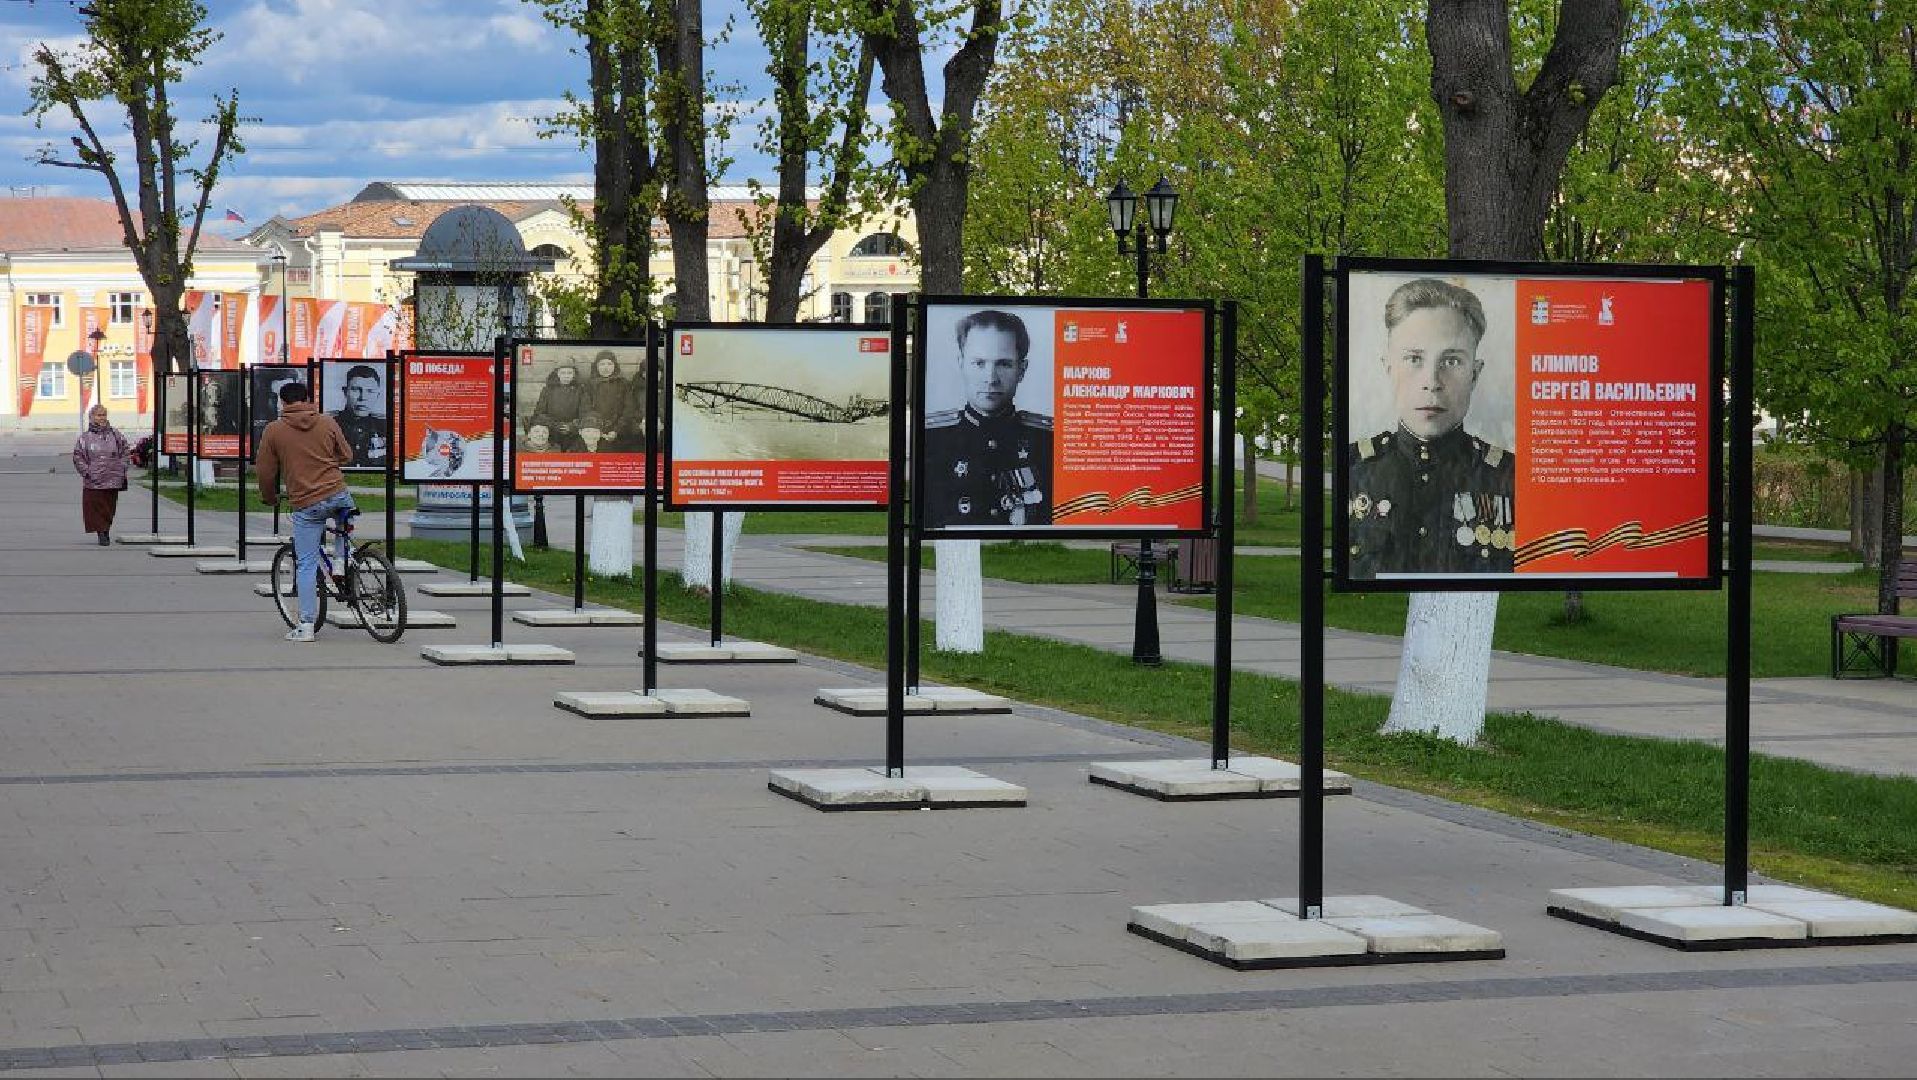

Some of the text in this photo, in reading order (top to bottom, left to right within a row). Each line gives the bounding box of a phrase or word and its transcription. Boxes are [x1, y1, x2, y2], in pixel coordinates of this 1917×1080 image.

[410, 362, 423, 374] 80
[1531, 354, 1599, 373] КЛИМОВ
[1063, 366, 1111, 380] МАРКОВ
[1063, 384, 1194, 399] АЛЕКСАНДР МАРКОВИЧ
[1531, 379, 1696, 402] СЕРГЕЙ ВАСИЛЬЕВИЧ
